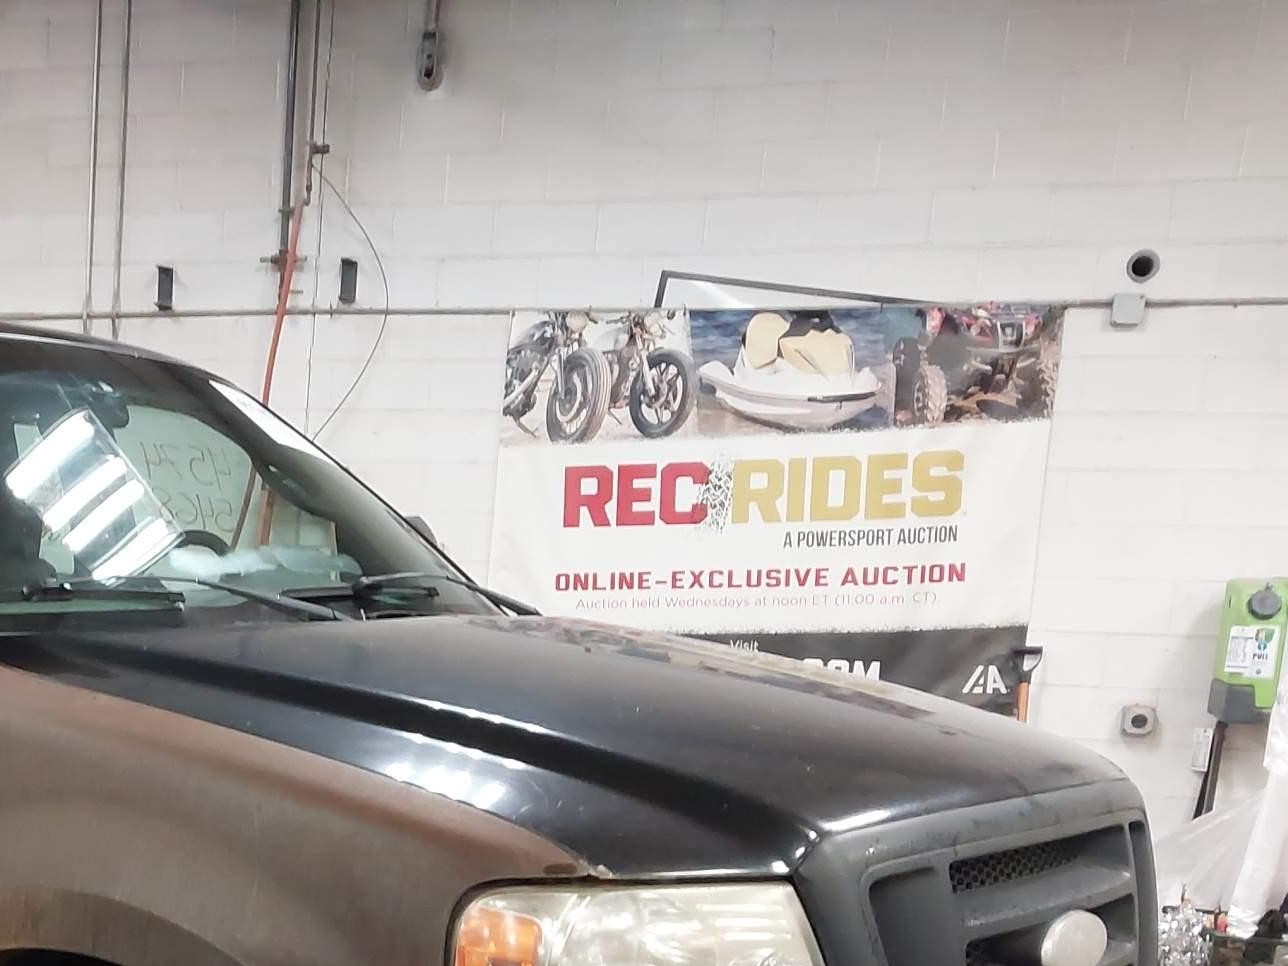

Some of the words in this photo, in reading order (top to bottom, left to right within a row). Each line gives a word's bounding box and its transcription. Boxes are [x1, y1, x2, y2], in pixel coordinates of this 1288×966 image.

[563, 461, 711, 528] REC
[731, 450, 965, 524] RIDES
[783, 531, 792, 549] A
[797, 528, 894, 548] POWERSPORT
[897, 524, 959, 545] AUCTION
[555, 567, 830, 591] ONLINE-EXCLUSIVE
[841, 562, 966, 587] AUCTION
[576, 598, 628, 610] Auction
[632, 596, 660, 609] held
[664, 596, 750, 610] Wednesdays
[755, 596, 767, 608] at
[772, 597, 807, 607] noon
